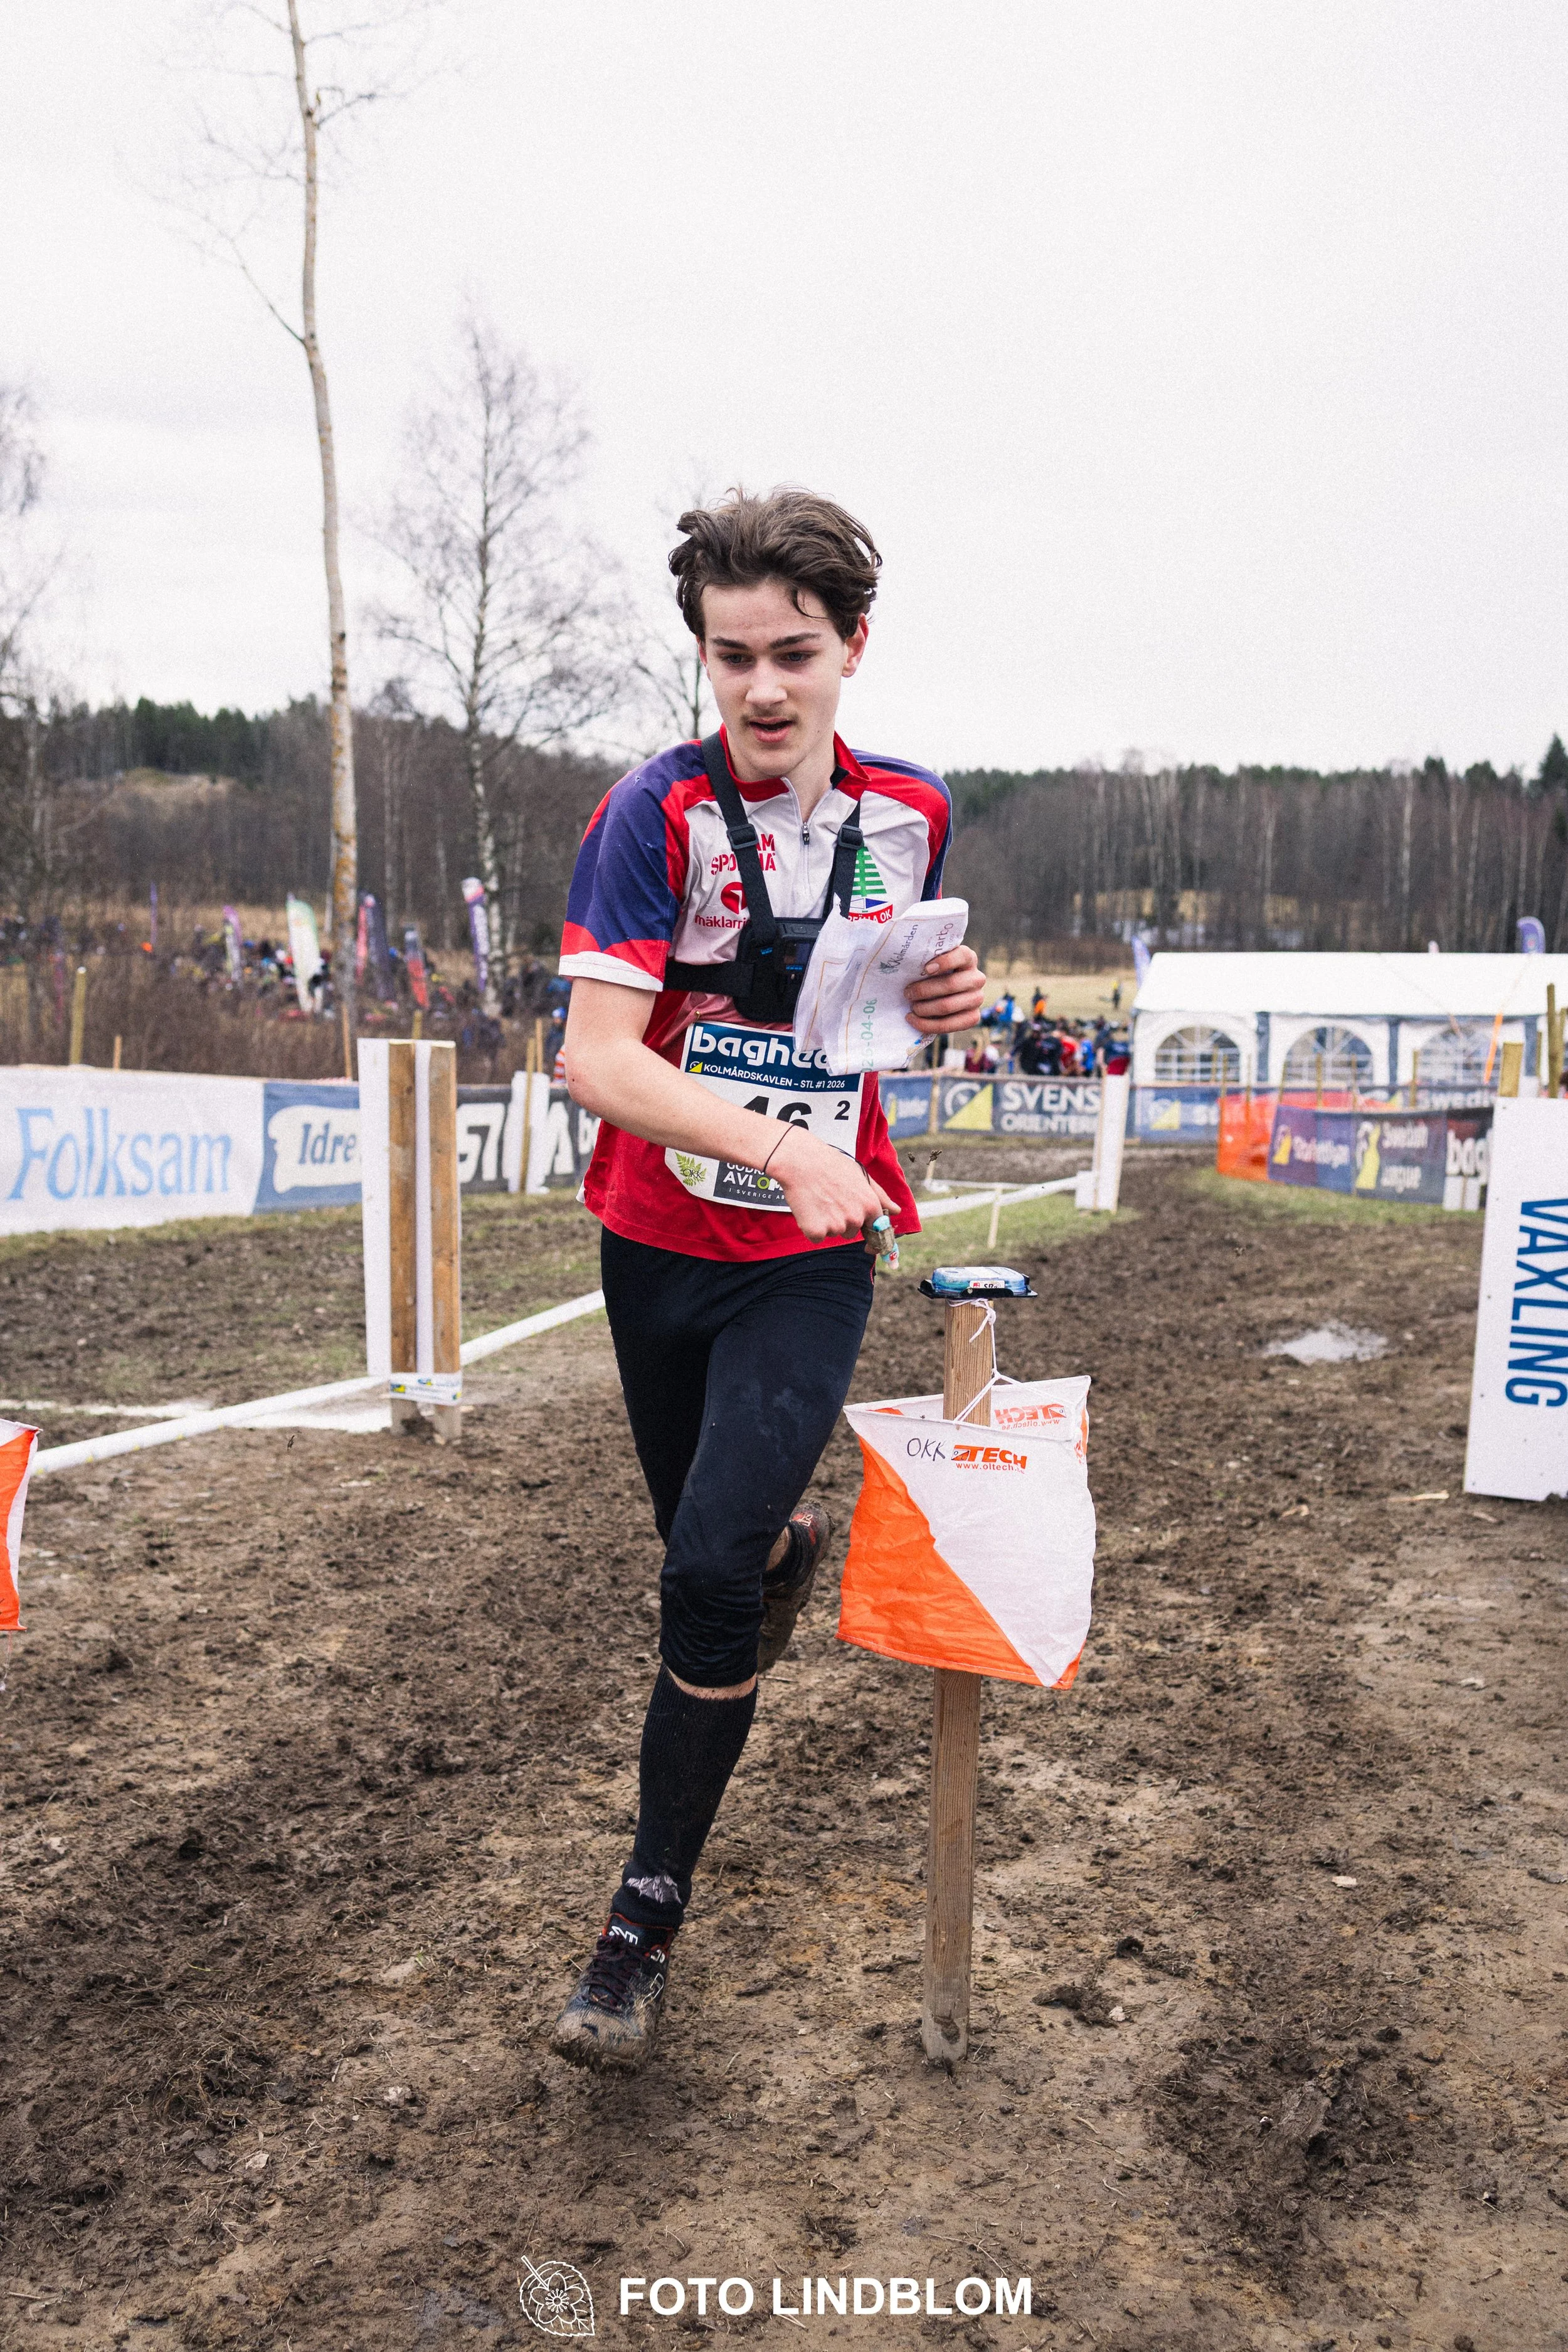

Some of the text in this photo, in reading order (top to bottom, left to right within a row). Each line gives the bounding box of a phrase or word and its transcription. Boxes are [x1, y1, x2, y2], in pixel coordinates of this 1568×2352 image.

[880, 909, 891, 921] OK
[703, 1064, 792, 1087] KOLMÅRDSKAVLEN
[800, 1080, 814, 1088] STL
[815, 1080, 825, 1088] #1
[827, 1080, 845, 1088] 2026
[1002, 1081, 1101, 1114] SVENS
[834, 1100, 850, 1120] 2
[6, 1107, 233, 1200] Folksam
[298, 1121, 361, 1165] Idre
[1445, 1129, 1493, 1186] bag
[682, 1168, 702, 1179] OKK
[736, 1189, 772, 1199] SVERIGE
[906, 1438, 945, 1462] OKK
